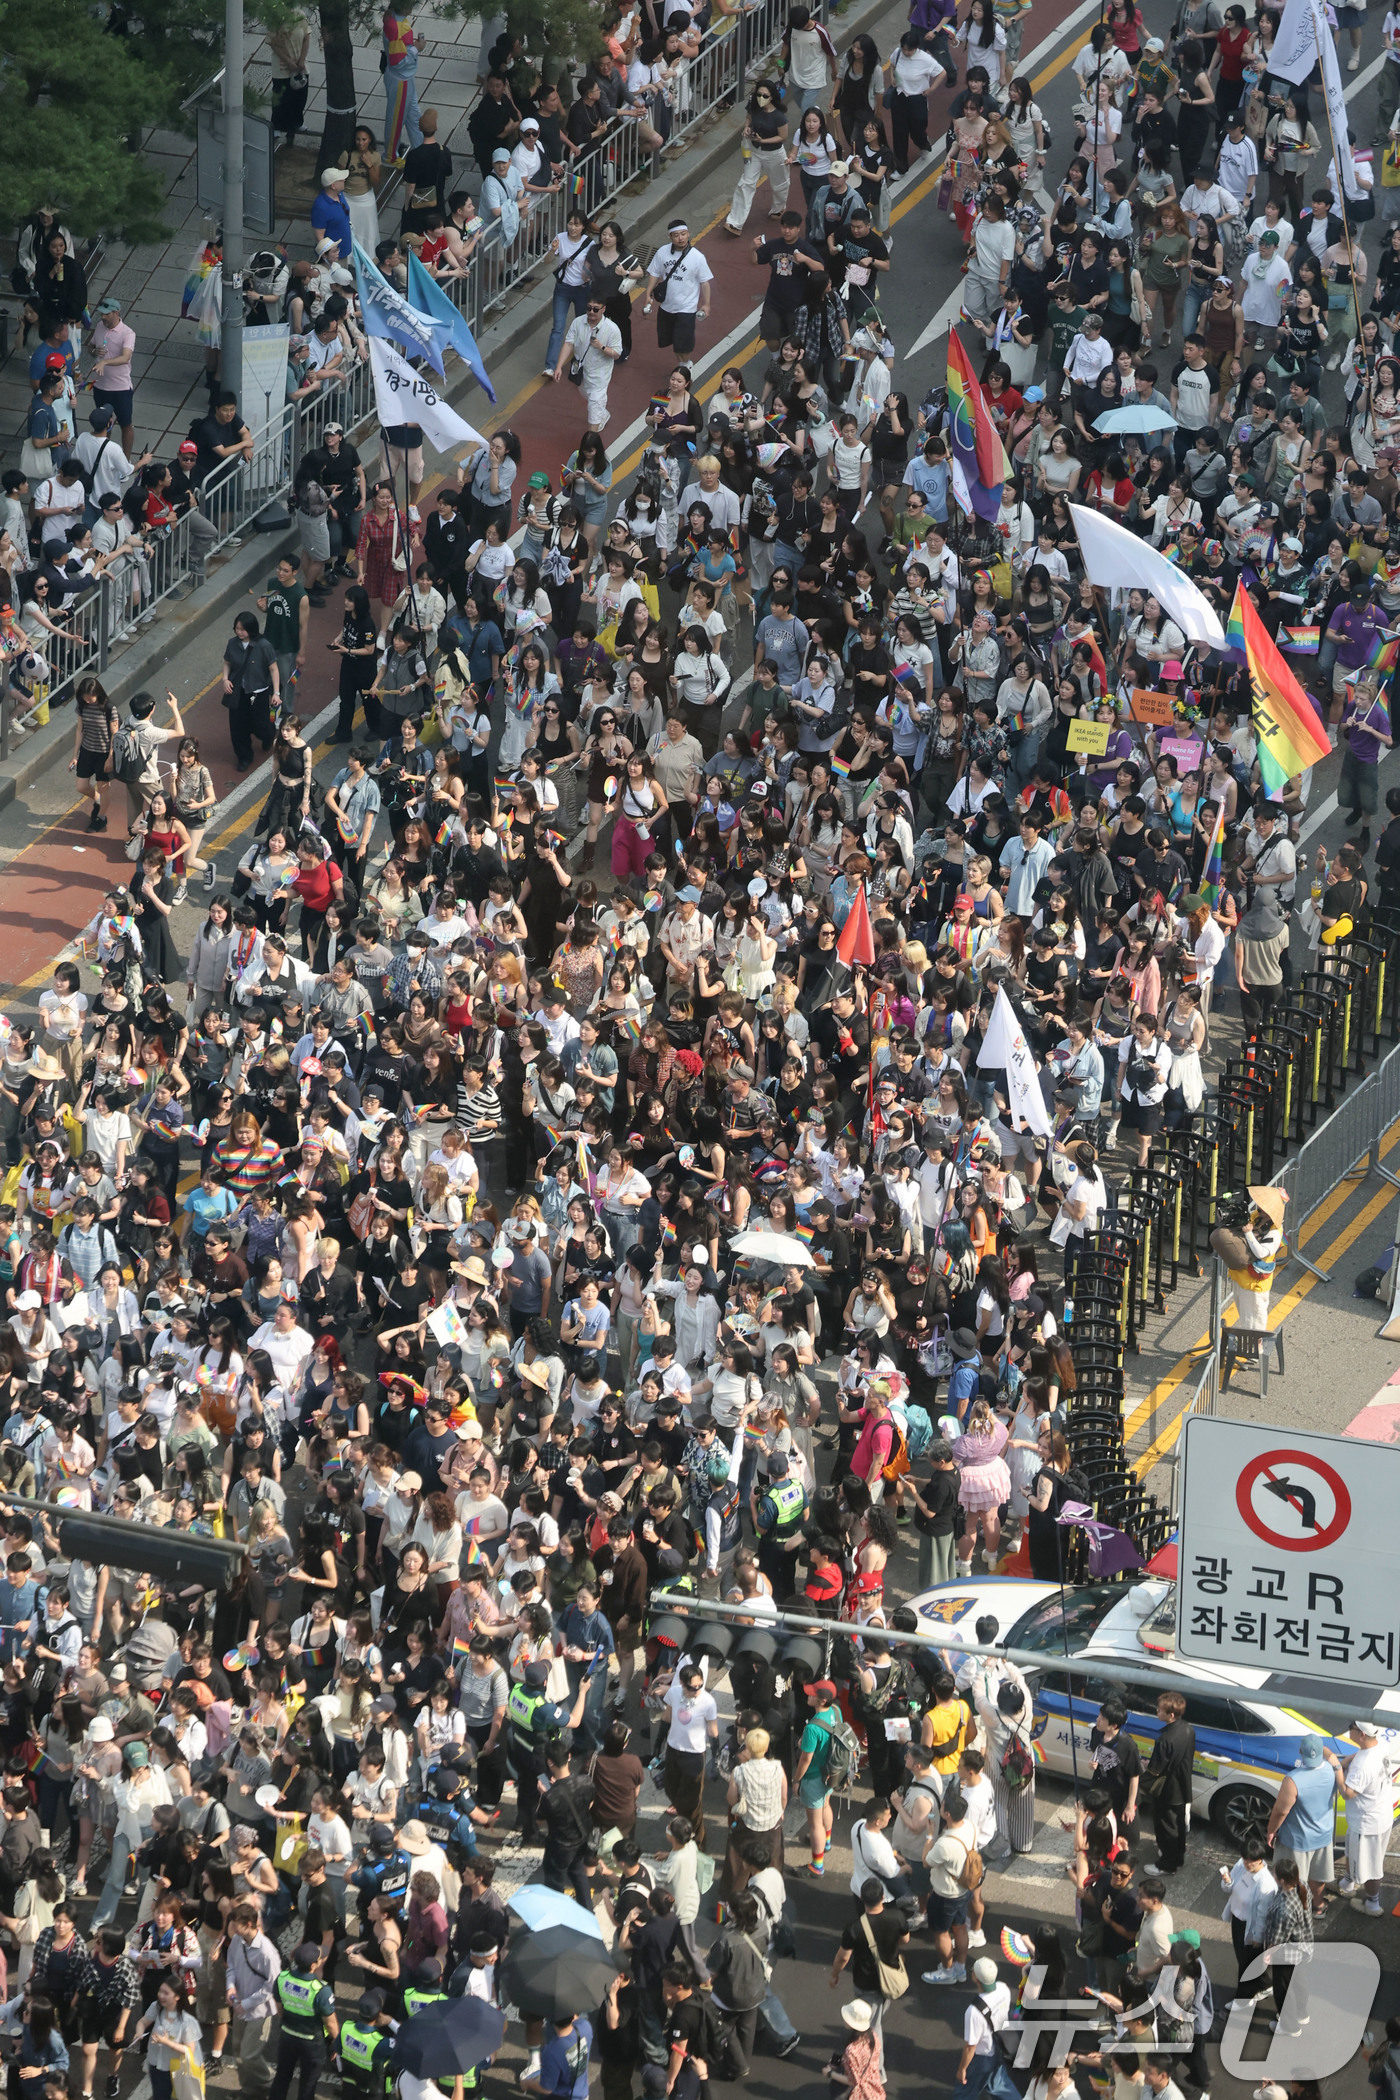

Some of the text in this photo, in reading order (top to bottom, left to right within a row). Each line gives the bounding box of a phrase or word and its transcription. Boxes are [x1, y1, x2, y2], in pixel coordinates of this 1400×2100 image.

[375, 1067, 399, 1082] venice
[1308, 1572, 1344, 1615] R
[1190, 1606, 1394, 1670] 좌회전금지
